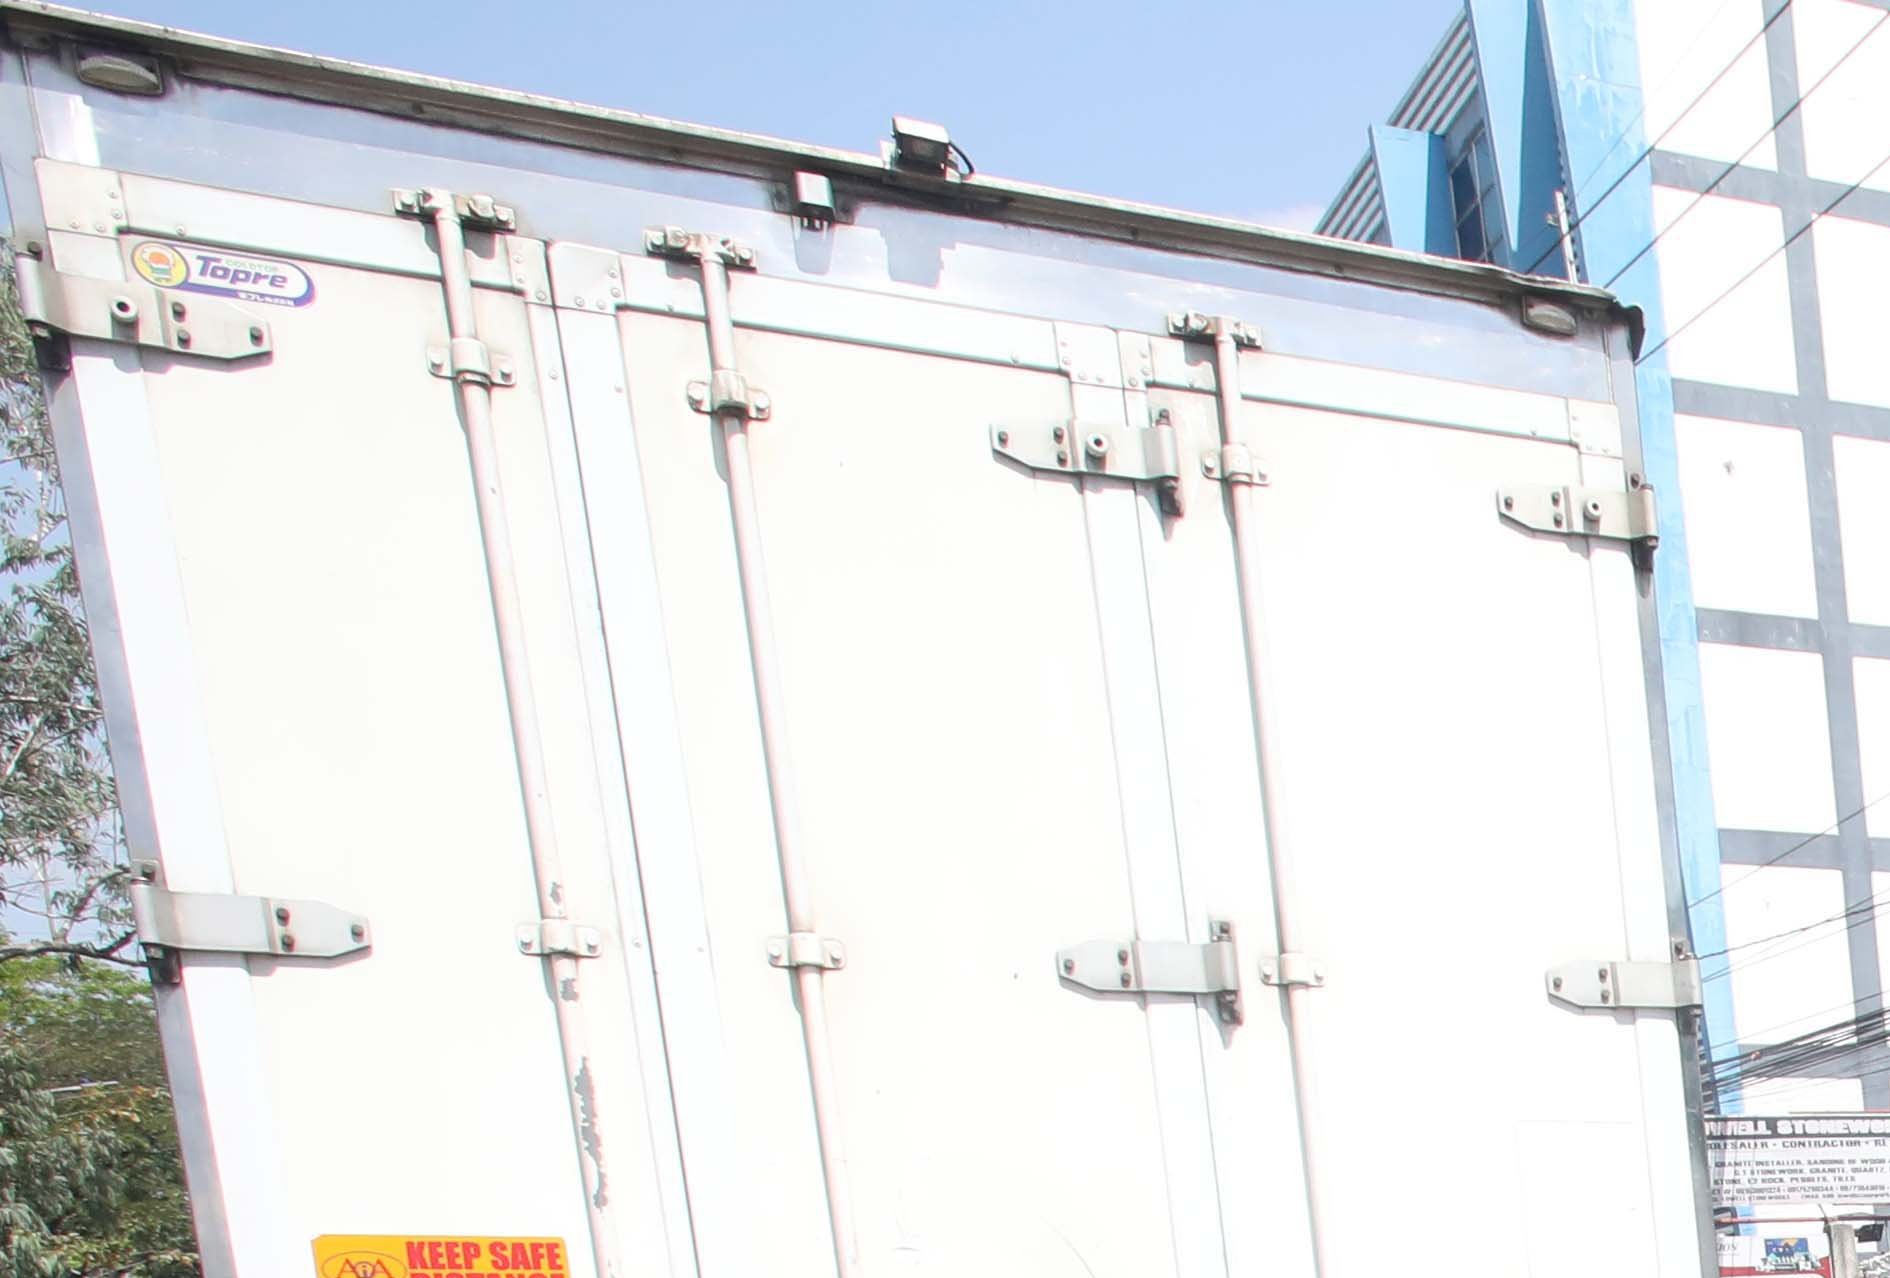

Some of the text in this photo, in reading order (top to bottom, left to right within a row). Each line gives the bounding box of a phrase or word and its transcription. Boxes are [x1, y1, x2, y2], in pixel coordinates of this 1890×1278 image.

[195, 254, 288, 289] Topre
[1781, 1139, 1861, 1149] CONTRACTOR
[405, 1241, 563, 1271] KEEP SAFE
